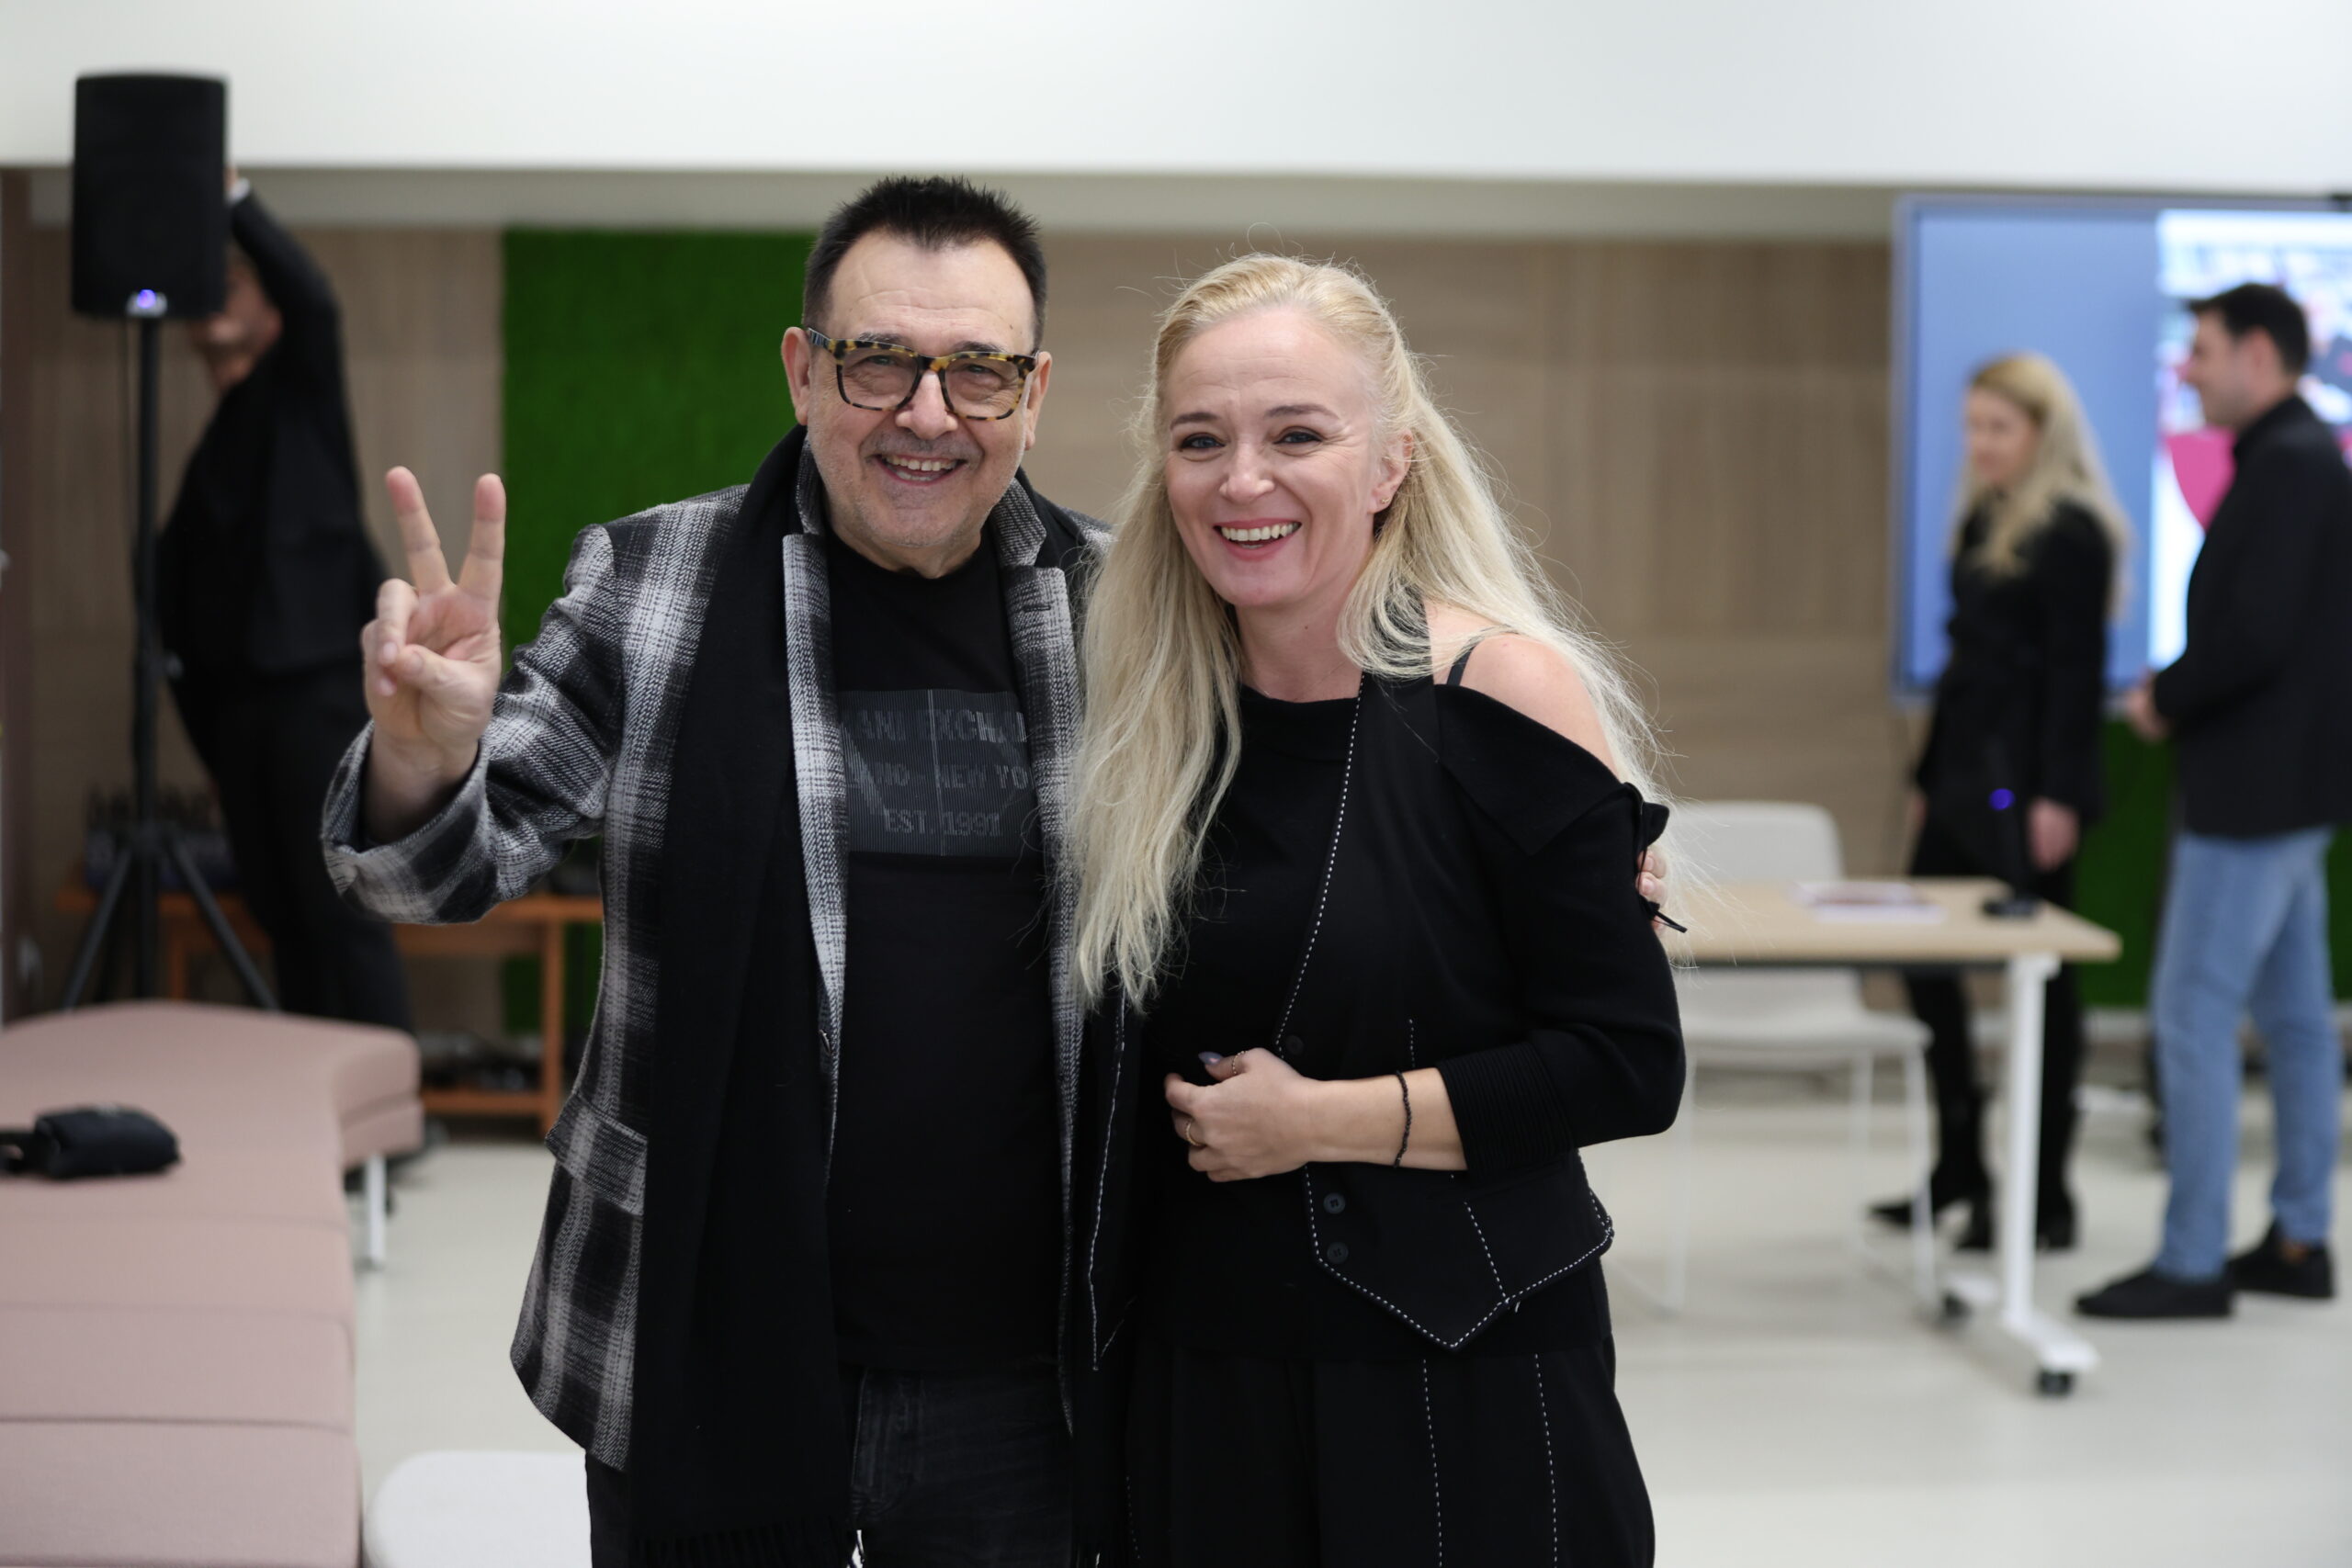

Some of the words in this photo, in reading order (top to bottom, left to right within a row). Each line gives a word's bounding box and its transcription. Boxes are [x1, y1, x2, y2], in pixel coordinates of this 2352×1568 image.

[994, 764, 1031, 790] YO
[884, 808, 936, 834] EST.
[942, 810, 1002, 837] 1991
